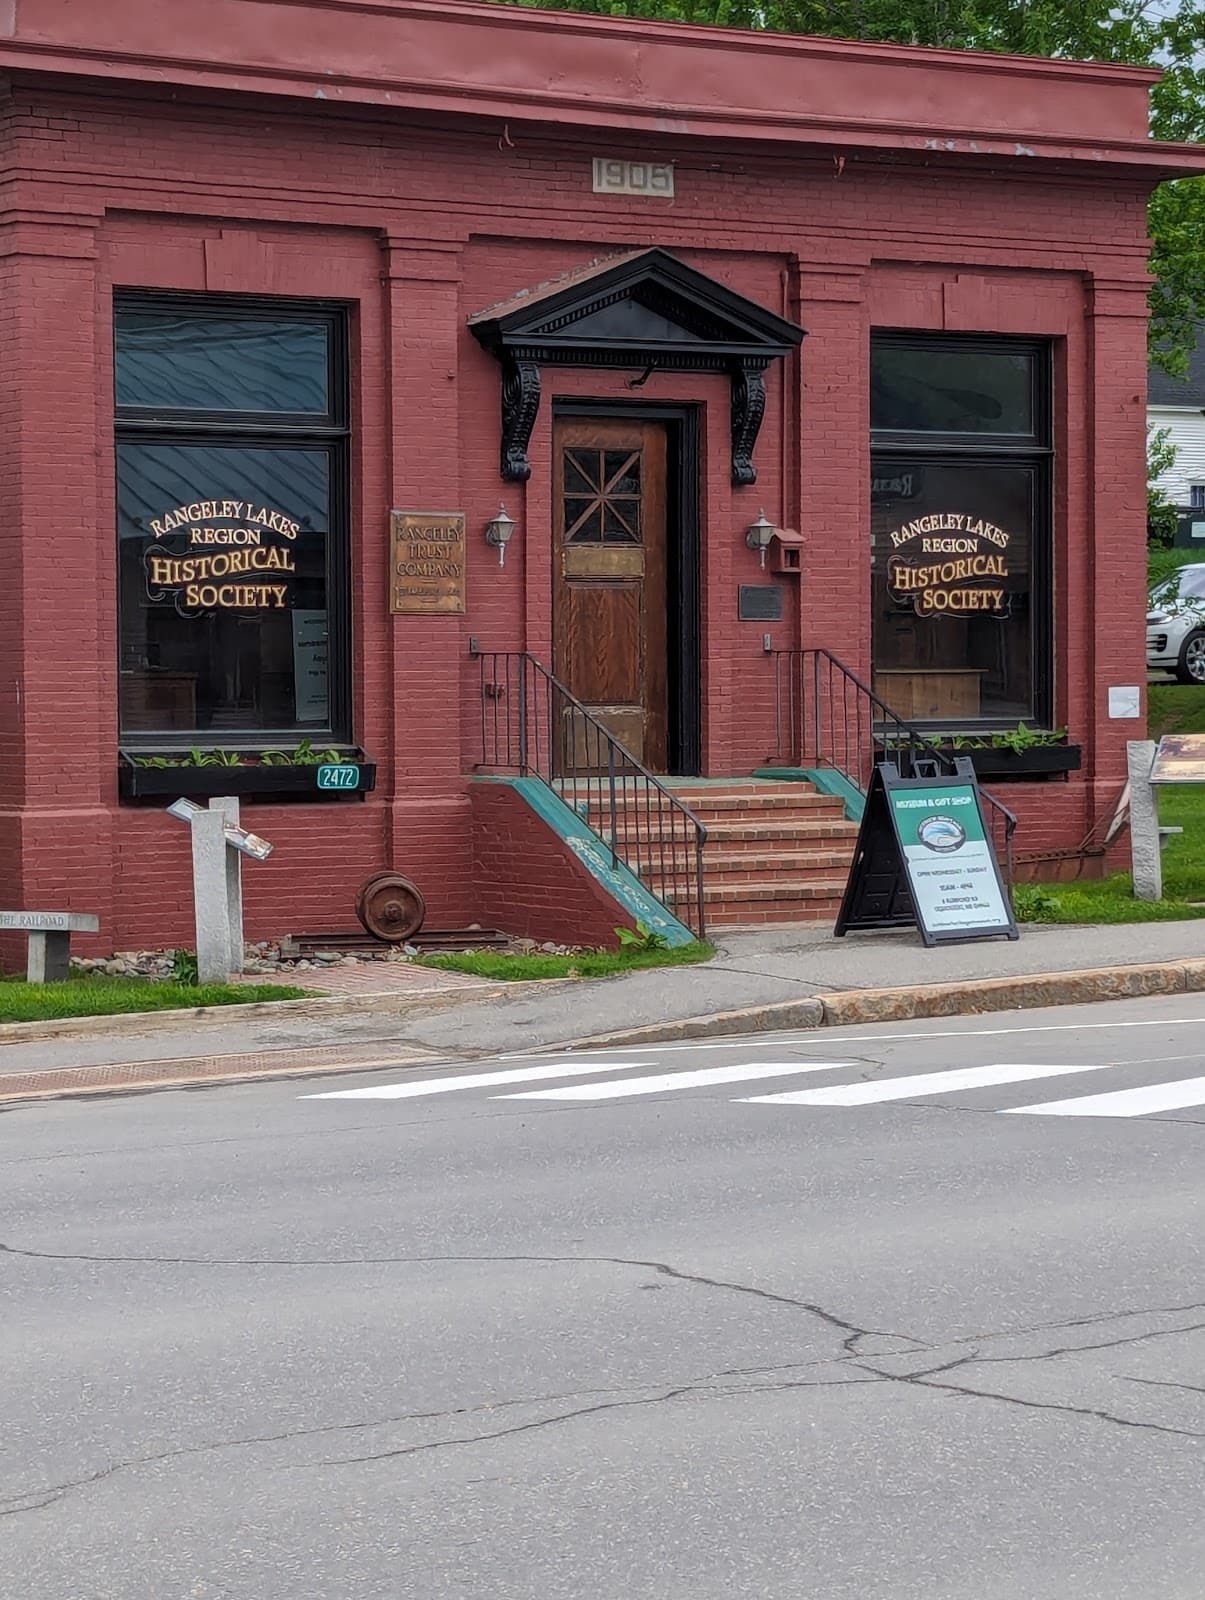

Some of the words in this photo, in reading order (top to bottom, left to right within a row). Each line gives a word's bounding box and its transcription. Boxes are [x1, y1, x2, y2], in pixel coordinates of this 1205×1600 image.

[150, 500, 243, 539] RANGELEY
[245, 503, 300, 540] LAKES
[190, 527, 261, 545] REGION
[396, 527, 461, 541] RANGELEY
[890, 513, 964, 549] RANGELEY
[965, 516, 1009, 549] LAKES
[409, 543, 451, 559] TRUST
[922, 538, 978, 553] REGION
[150, 546, 296, 584] HISTORICAL
[397, 562, 461, 577] COMPANY
[893, 555, 1009, 590] HISTORICAL
[186, 584, 288, 608] SOCIETY
[923, 589, 1004, 610] SOCIETY
[323, 769, 354, 786] 2472
